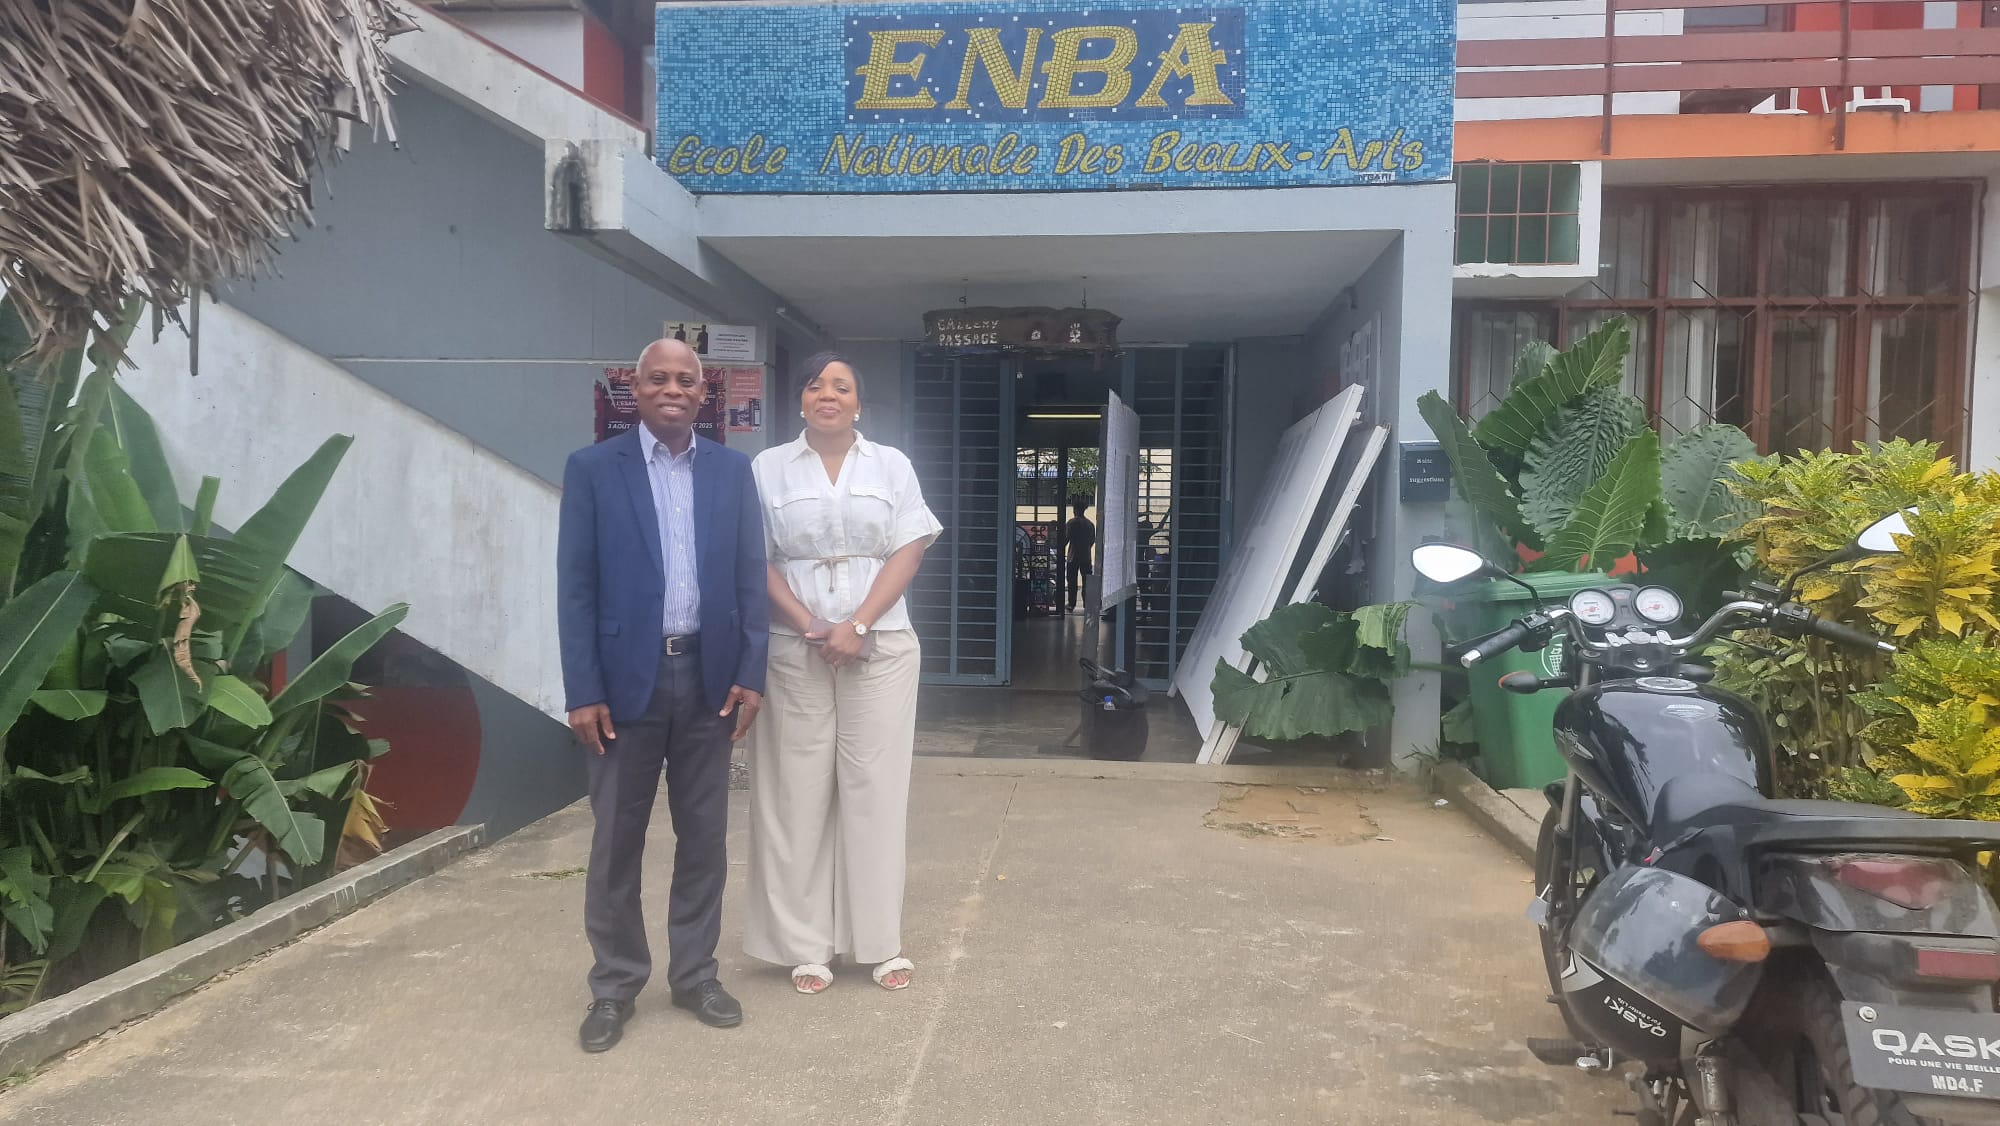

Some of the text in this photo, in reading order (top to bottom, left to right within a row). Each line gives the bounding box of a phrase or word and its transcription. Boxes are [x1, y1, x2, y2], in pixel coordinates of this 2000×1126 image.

[854, 22, 1234, 111] ENBA
[665, 133, 789, 176] Ecole
[819, 131, 1040, 177] Nationale
[1053, 130, 1124, 176] Des
[938, 332, 998, 347] PASSAGE
[698, 422, 713, 430] 2025
[1603, 995, 1667, 1038] QASKI
[1888, 1057, 1917, 1067] POUR
[1920, 1059, 1942, 1069] UNE
[1945, 1062, 1962, 1070] VIE
[1931, 1074, 1984, 1093] MD4.F
